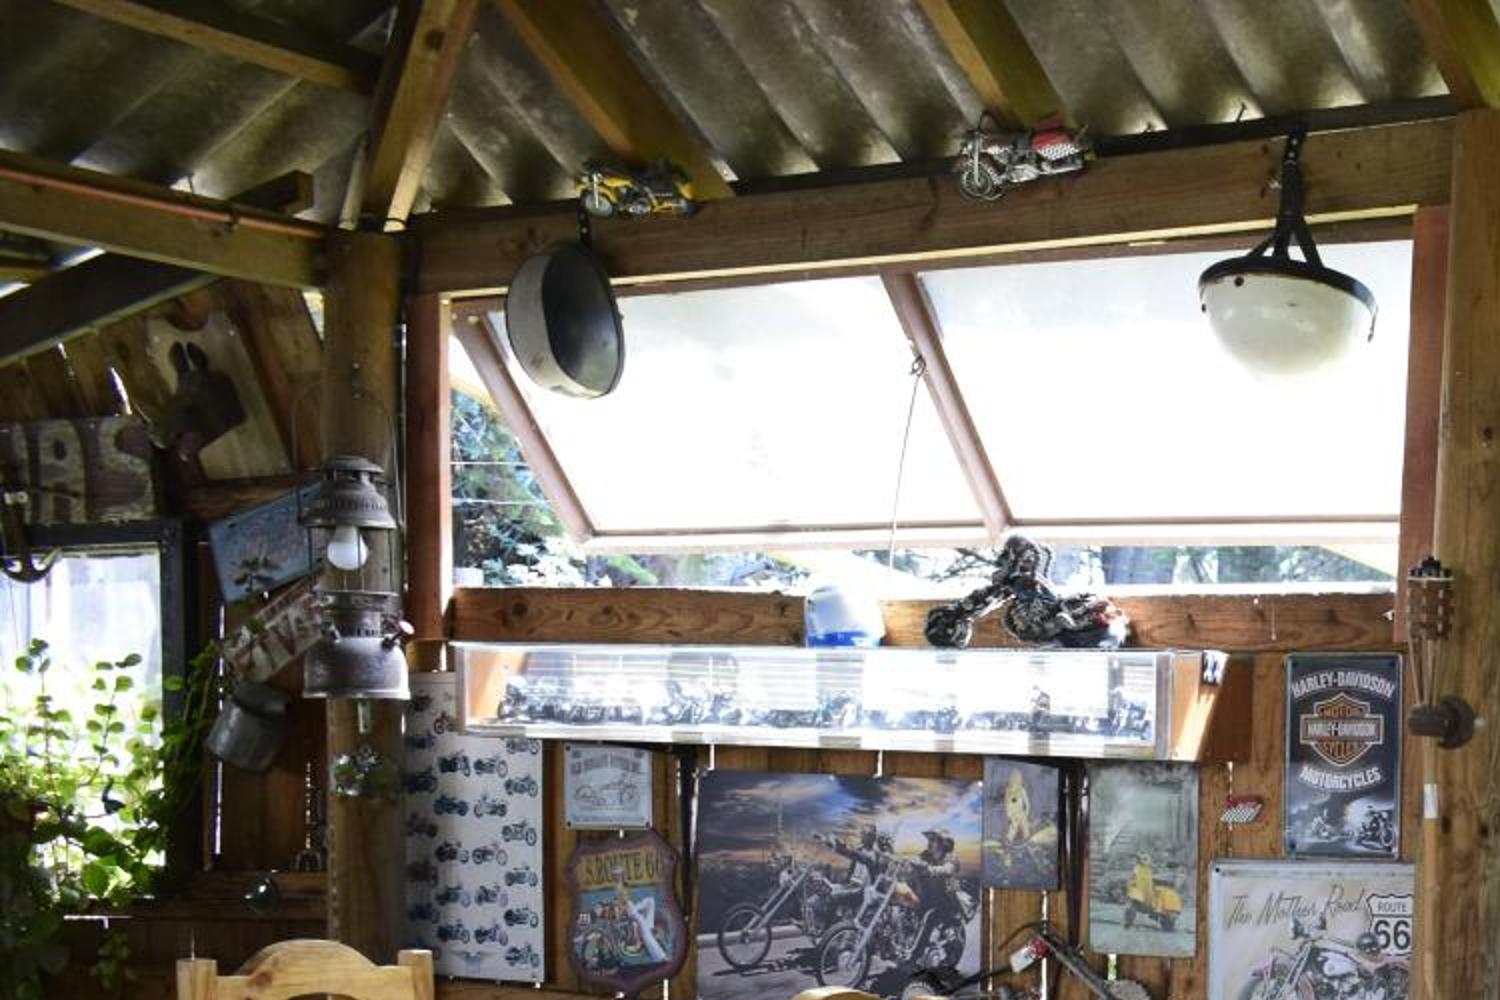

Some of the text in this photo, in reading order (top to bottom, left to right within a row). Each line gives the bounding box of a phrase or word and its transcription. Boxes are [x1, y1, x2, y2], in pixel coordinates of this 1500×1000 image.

[1291, 670, 1395, 699] HARLEY-DAVIDSON
[1300, 766, 1381, 789] MOTORCYCLES
[1377, 901, 1407, 913] ROUTE
[1374, 919, 1411, 951] 66
